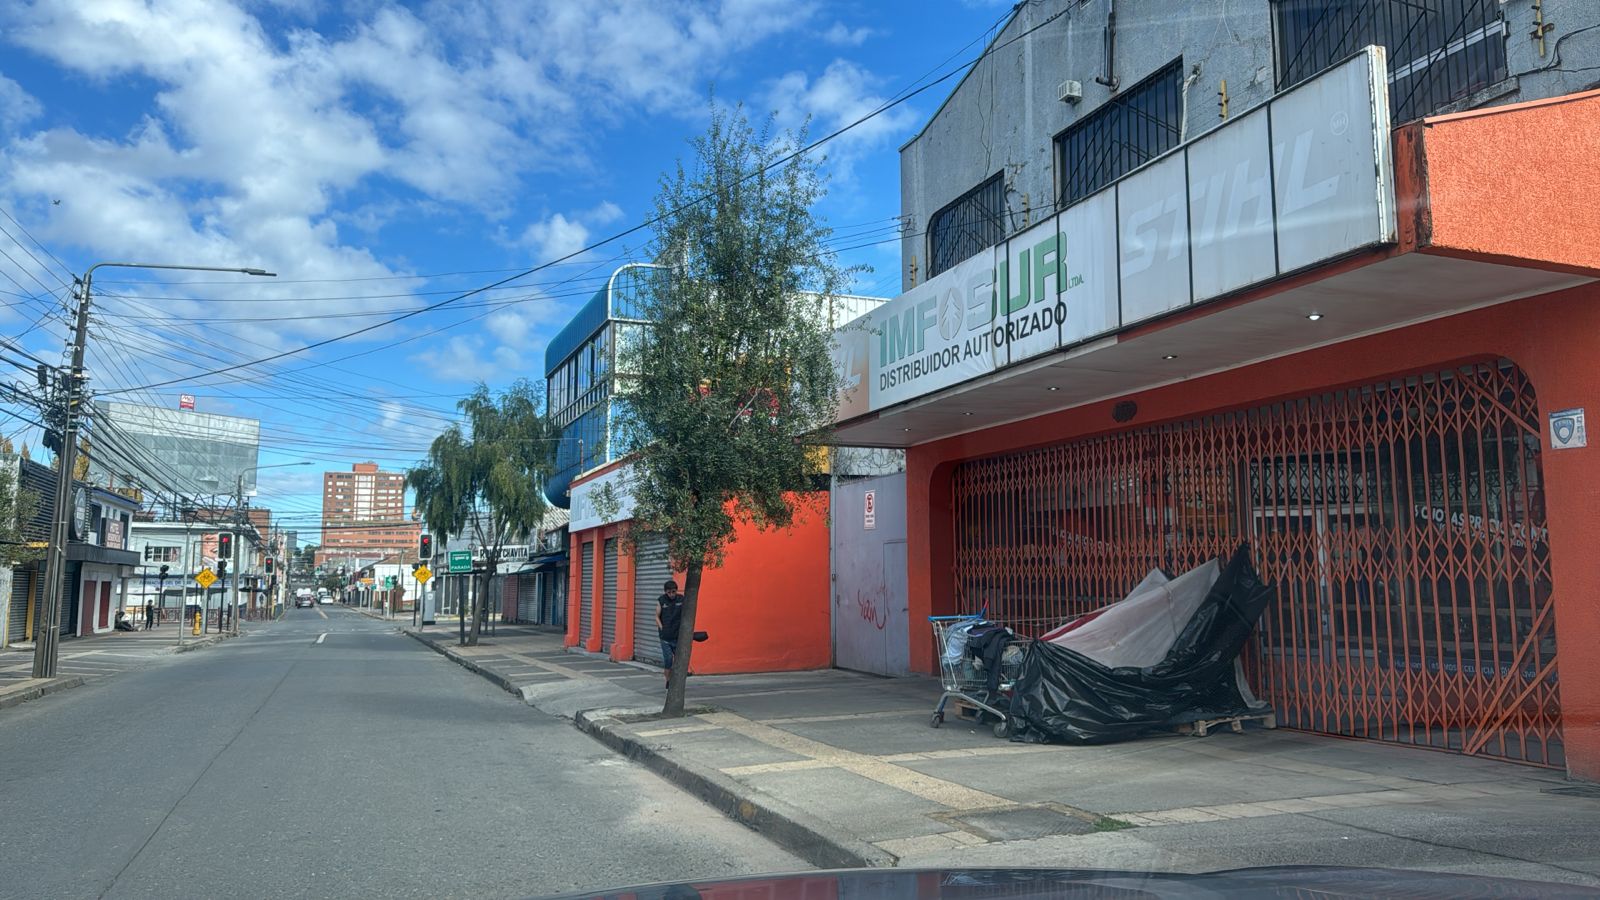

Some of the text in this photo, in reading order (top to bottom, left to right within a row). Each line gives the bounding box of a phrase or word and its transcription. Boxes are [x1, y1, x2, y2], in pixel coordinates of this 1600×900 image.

[1121, 128, 1341, 279] STIHL
[880, 344, 961, 392] DISTRIBUIDOR
[963, 301, 1068, 361] AUTORIZADO
